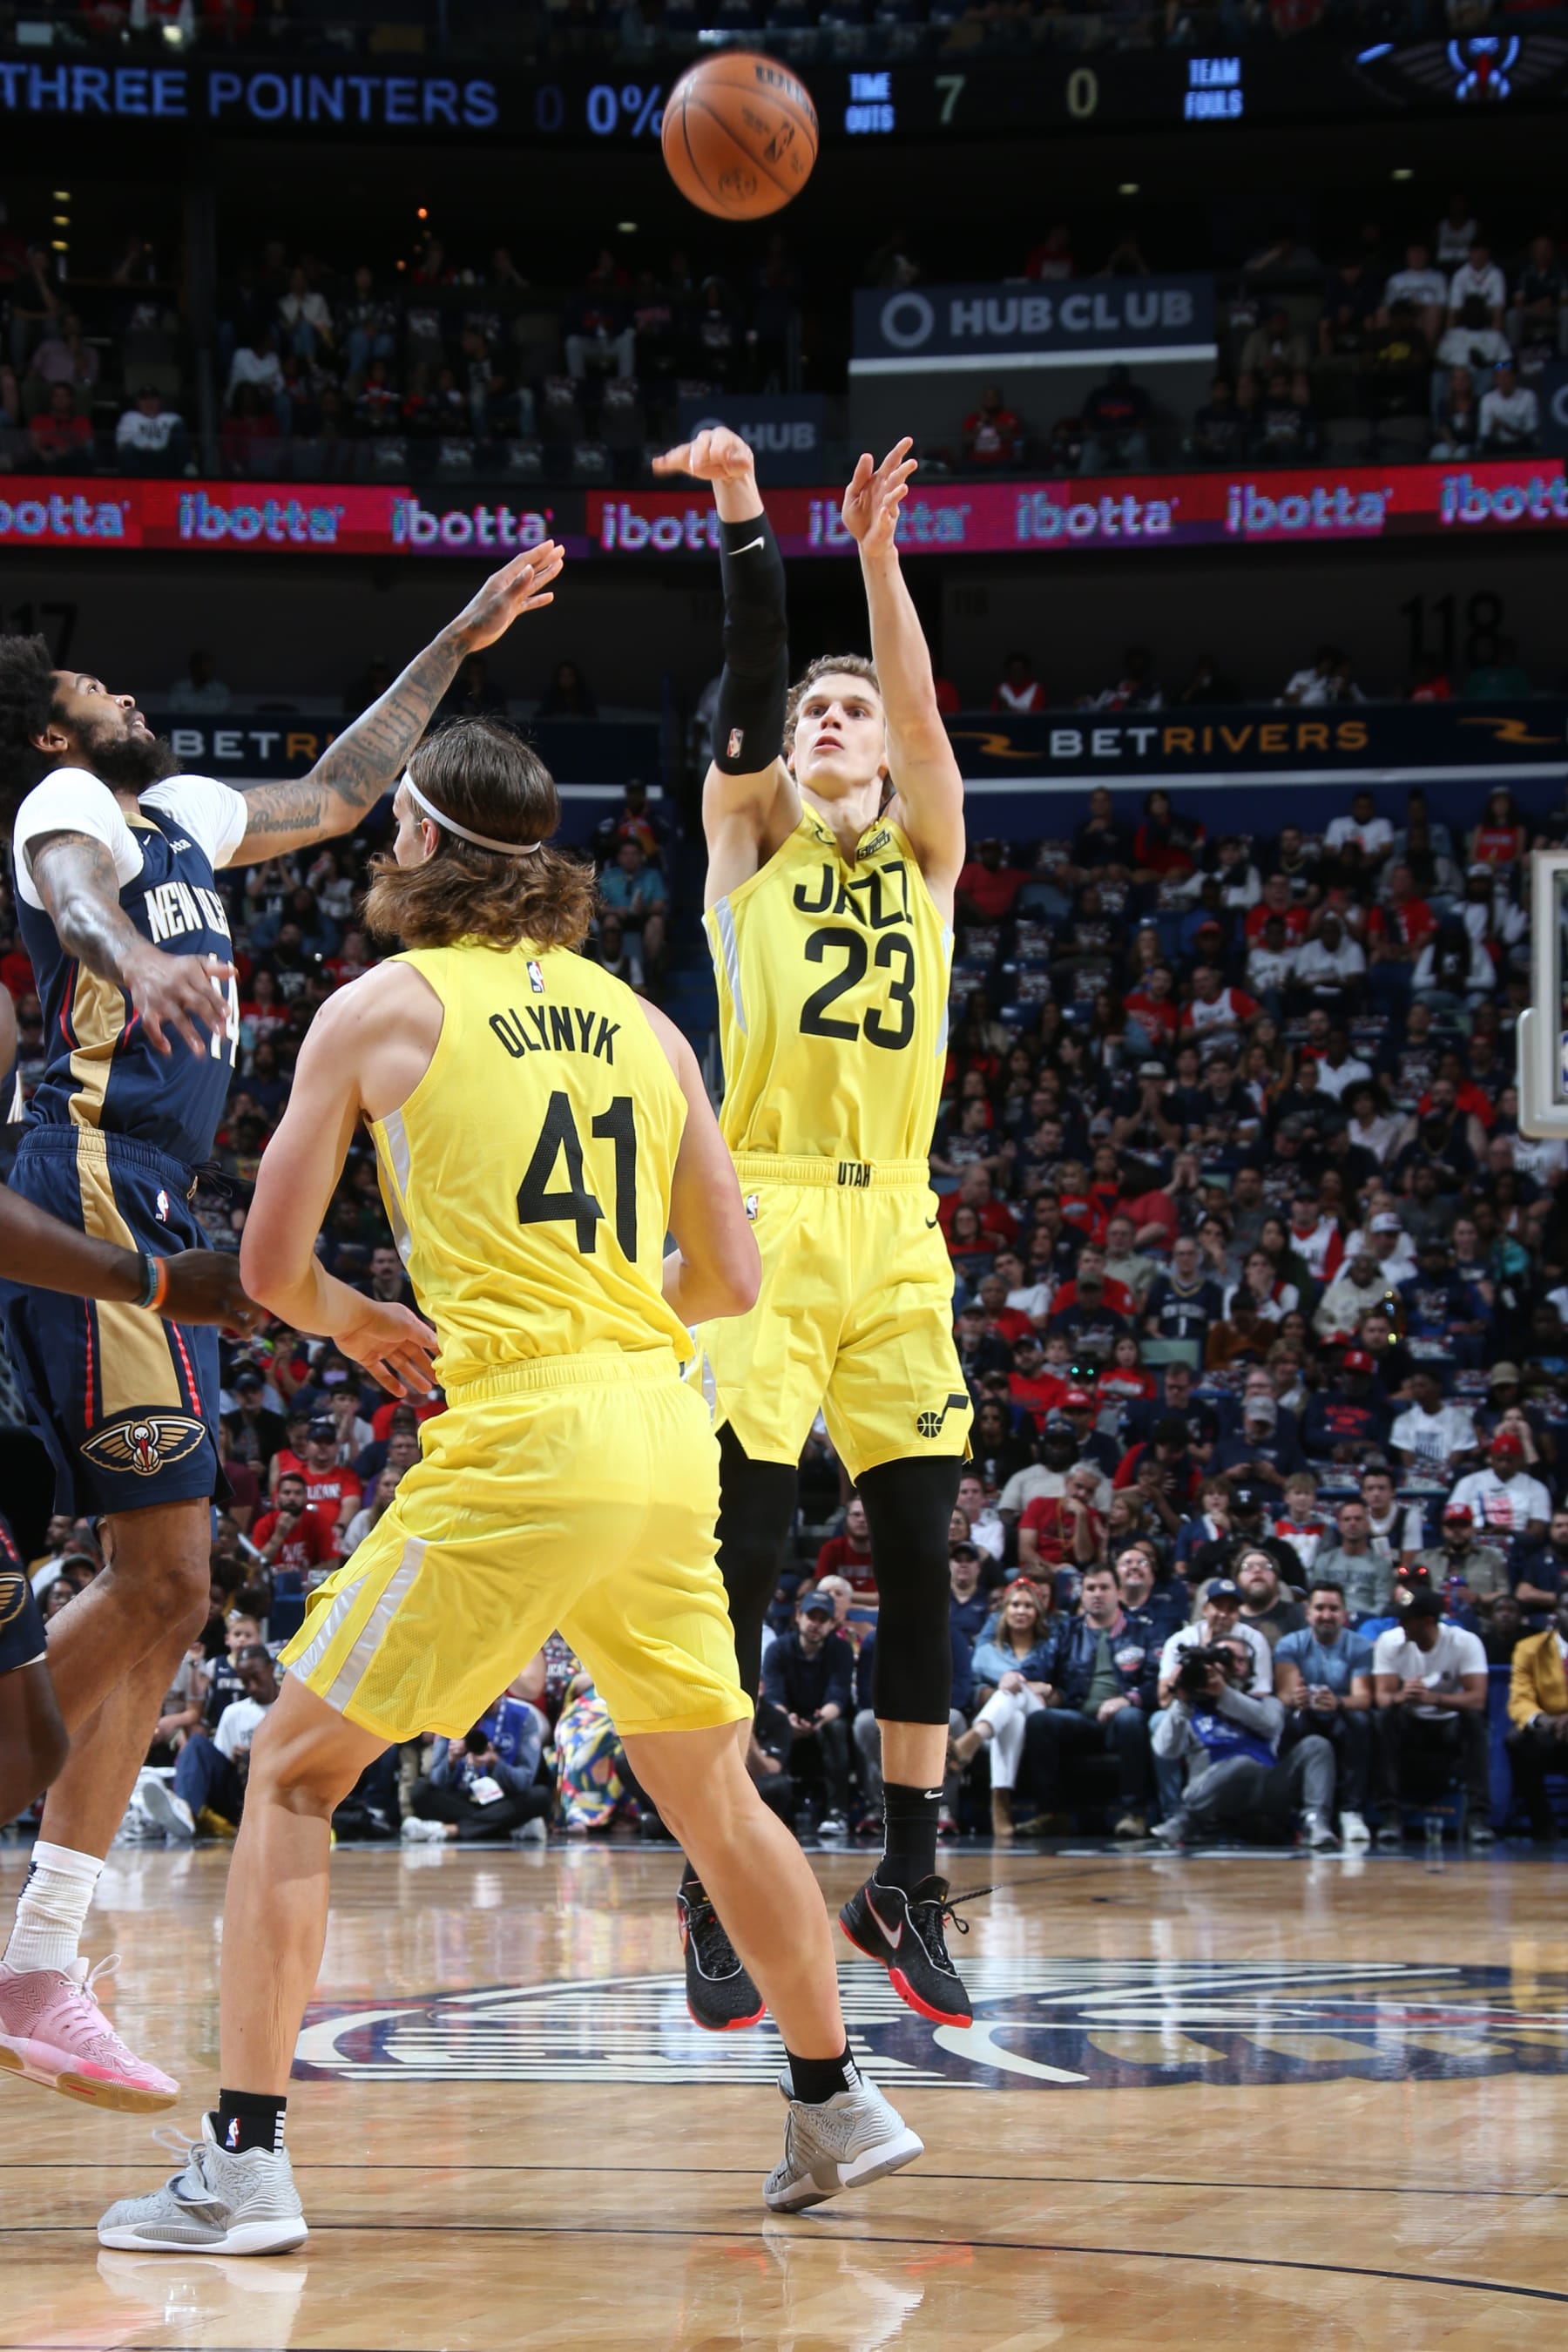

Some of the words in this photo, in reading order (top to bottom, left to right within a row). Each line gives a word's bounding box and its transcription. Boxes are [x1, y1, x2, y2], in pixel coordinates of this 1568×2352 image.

[849, 72, 892, 102] TIME
[1067, 69, 1098, 118] 0
[1189, 57, 1241, 86] TEAM
[0, 61, 187, 116] THREE
[208, 70, 497, 127] POINTERS
[586, 83, 663, 138] 0%
[845, 105, 896, 135] OUTS
[935, 75, 966, 124] 7
[1184, 90, 1244, 120] FOULS
[950, 295, 1052, 337] HUB
[1059, 289, 1194, 332] CLUB
[0, 493, 124, 537] otta
[179, 491, 340, 544] ibotta
[391, 498, 548, 547] ibotta
[1017, 491, 1173, 540] ibotta
[1227, 484, 1385, 534] ibotta
[1439, 473, 1568, 524] ibott
[602, 502, 720, 551] ibott
[808, 498, 965, 549] ibtta
[1049, 721, 1369, 759] BETRIVERS
[144, 881, 204, 943] NEW
[793, 860, 913, 930] JAZZ
[800, 927, 915, 1051] 23
[489, 1005, 621, 1065] OLYNYK
[517, 1091, 637, 1263] 41
[838, 1161, 871, 1188] UTAH
